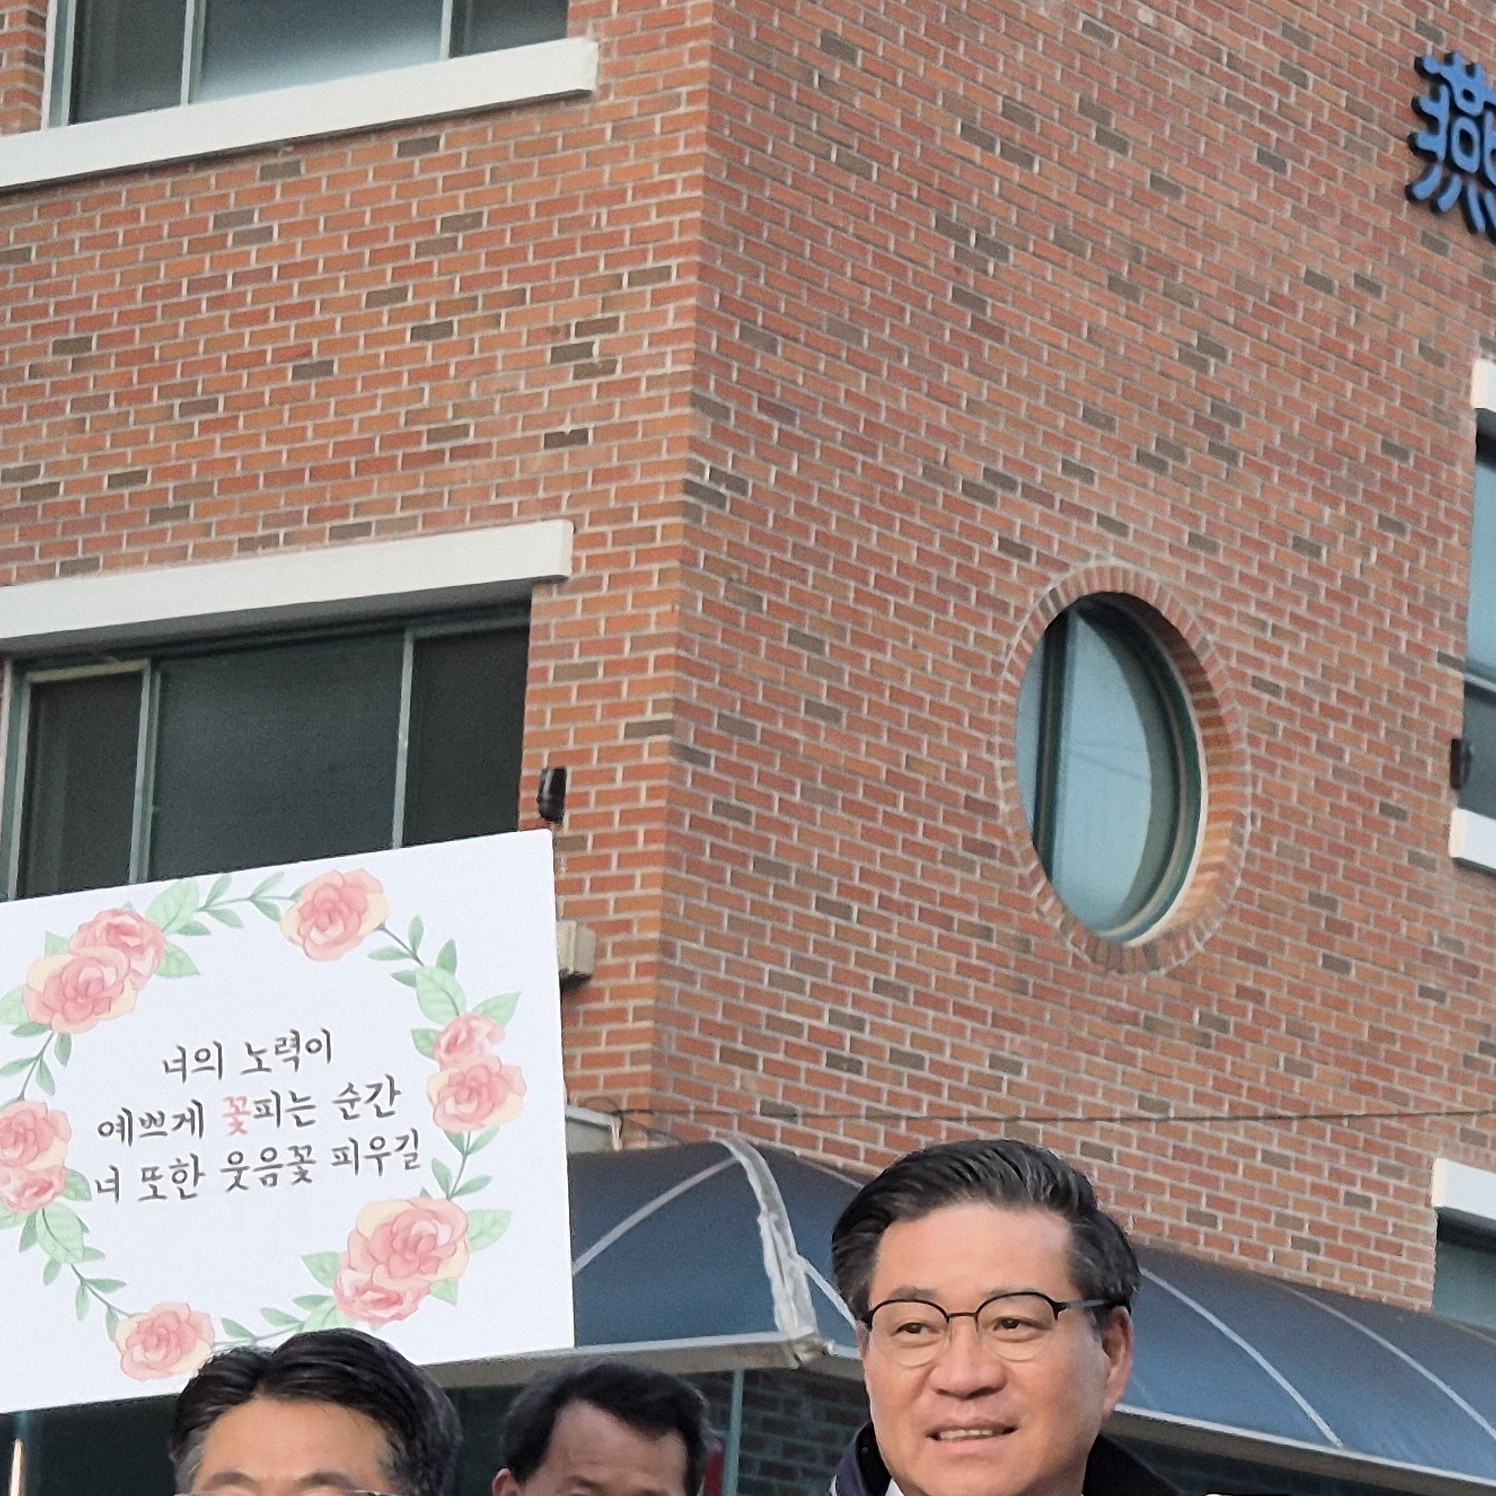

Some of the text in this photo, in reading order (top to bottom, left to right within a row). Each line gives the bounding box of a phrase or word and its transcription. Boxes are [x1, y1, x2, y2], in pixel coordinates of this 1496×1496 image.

[161, 1028, 334, 1084] 너의 노력이
[97, 1074, 403, 1146] 예쁘게 꽃피는 순간
[94, 1128, 423, 1203] 너 또한 웃음꽃 피우길
